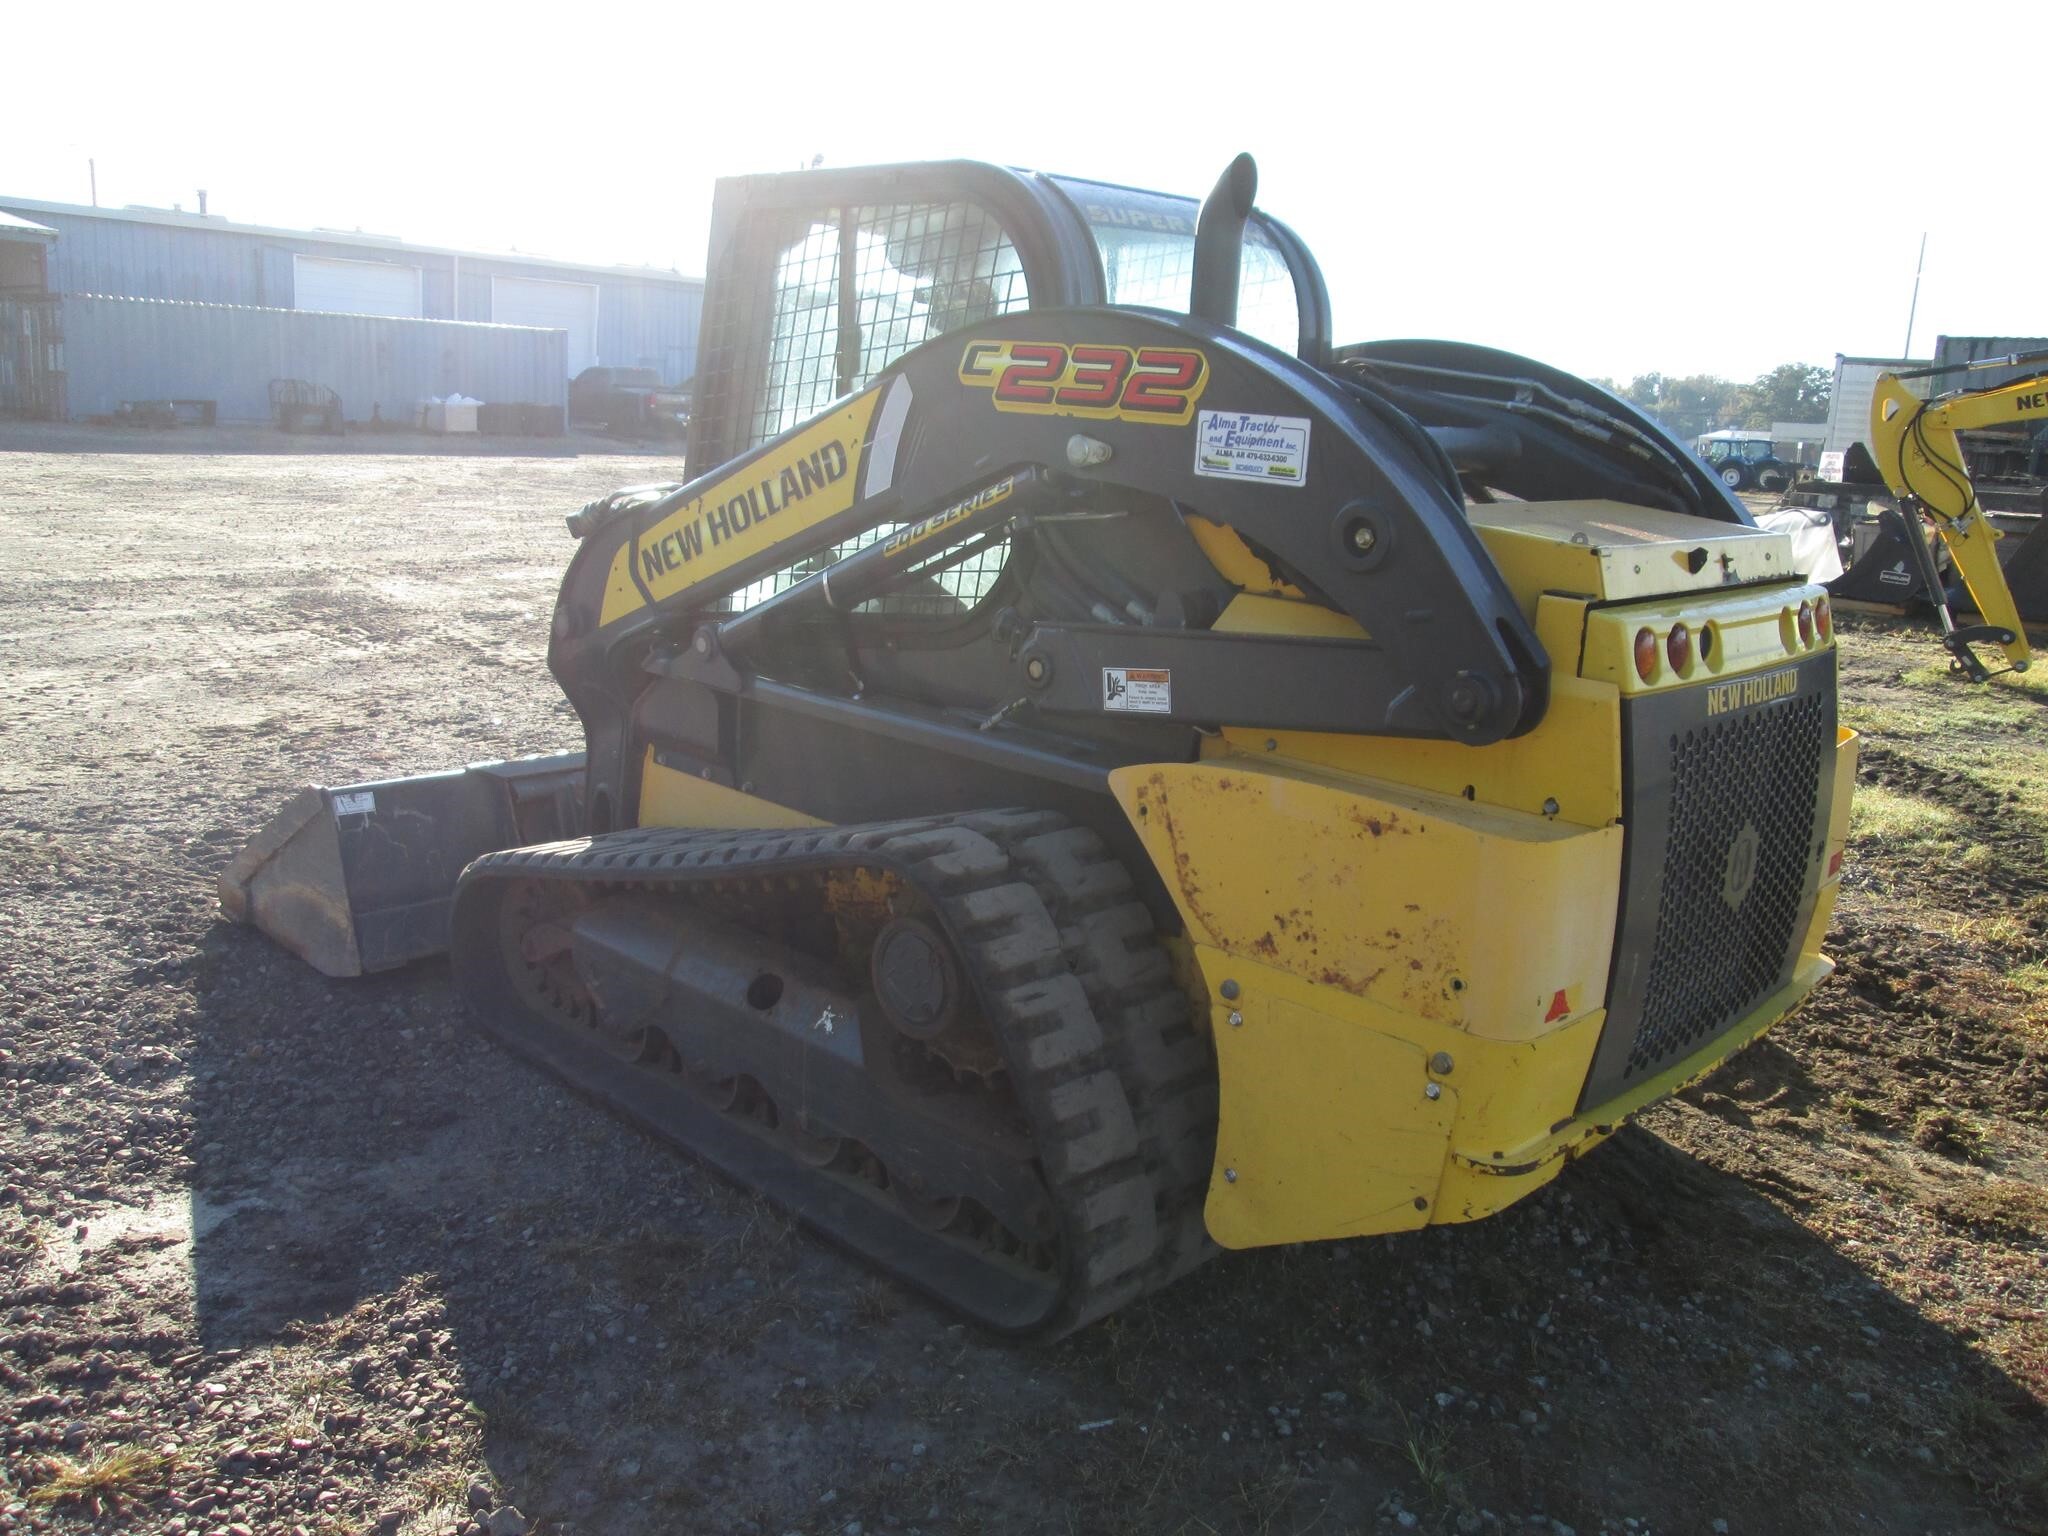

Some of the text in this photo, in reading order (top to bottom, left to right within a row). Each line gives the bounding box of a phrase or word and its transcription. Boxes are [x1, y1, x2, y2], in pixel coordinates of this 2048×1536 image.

[2016, 391, 2048, 411] NE
[1208, 413, 1280, 433] Alma Tractor
[1209, 435, 1222, 443] and
[1224, 430, 1284, 449] Equipment
[1236, 451, 1245, 459] AR
[641, 439, 848, 582] NEW HOLLAND
[932, 480, 1011, 526] SERIES
[1708, 669, 1798, 717] NEW HOLLAND
